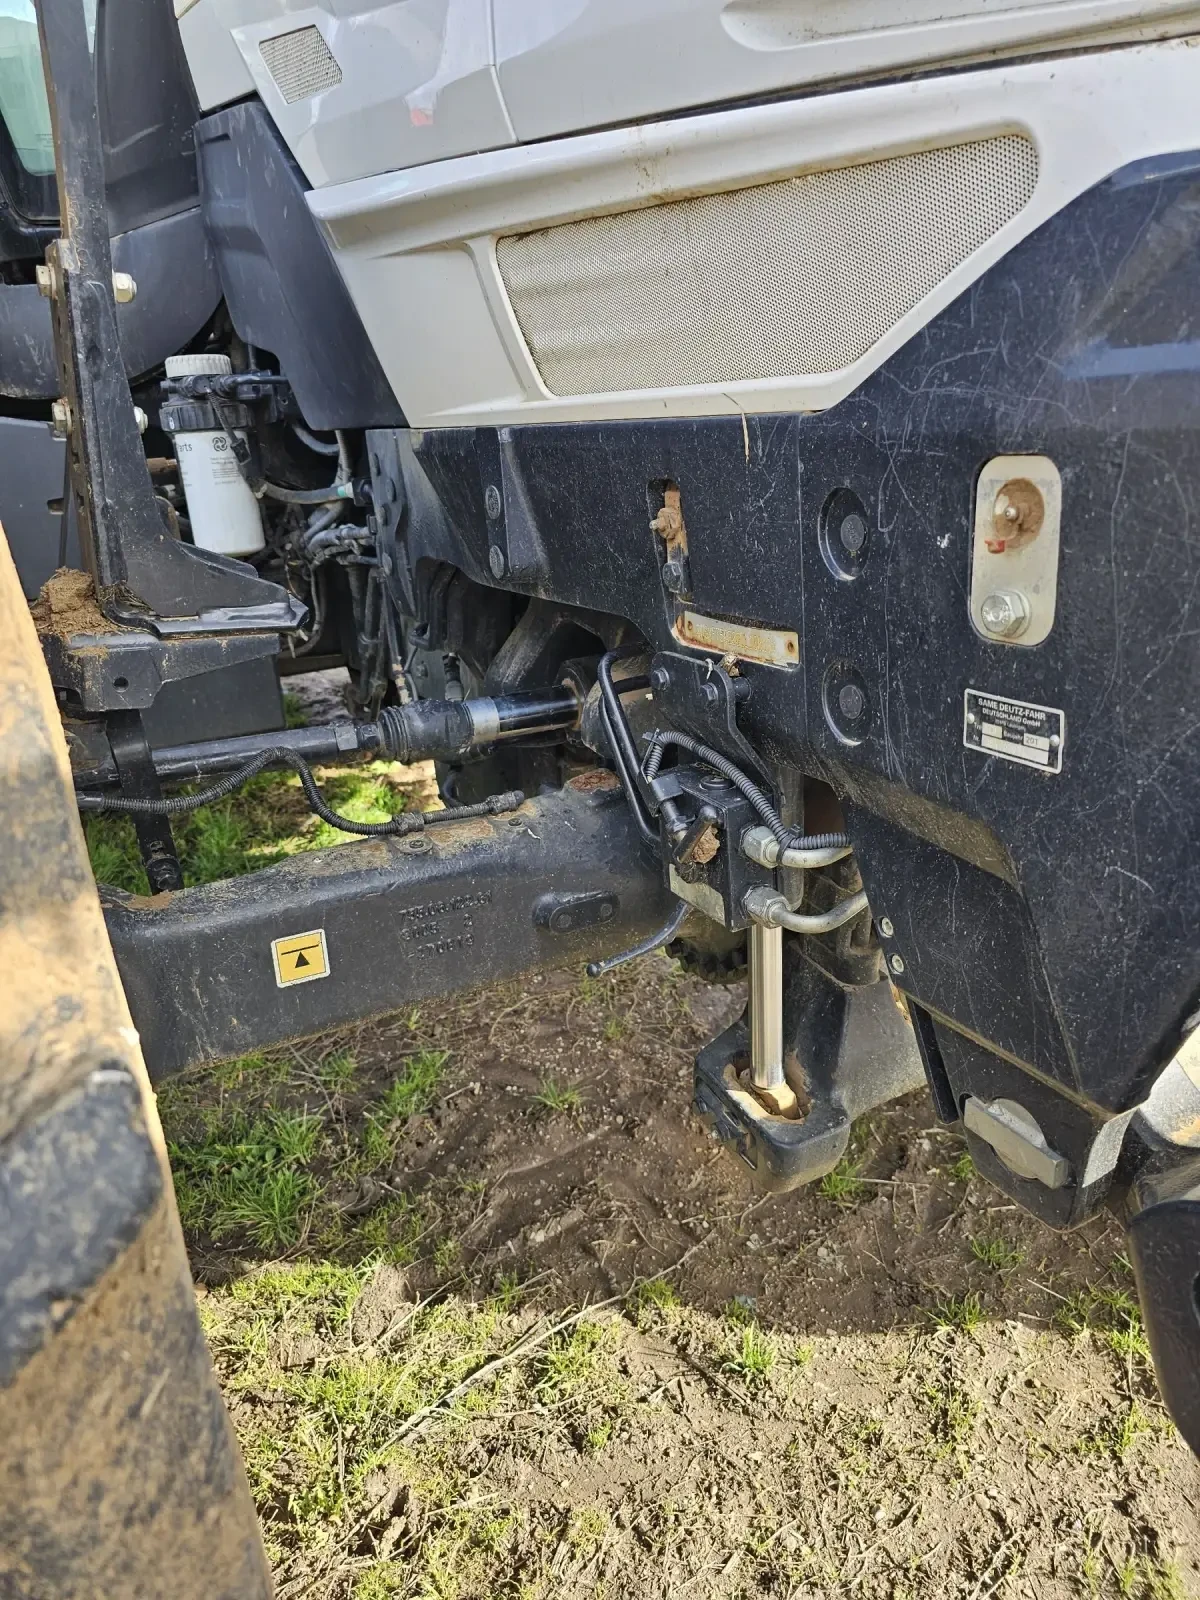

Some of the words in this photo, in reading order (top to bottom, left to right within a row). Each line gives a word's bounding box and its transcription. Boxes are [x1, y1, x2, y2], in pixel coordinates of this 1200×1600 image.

[978, 698, 998, 710] SAME
[999, 703, 1046, 721] DEUTZ-FAHR
[982, 707, 1022, 723] DEUTSCHLAND
[1022, 717, 1041, 727] GmbH
